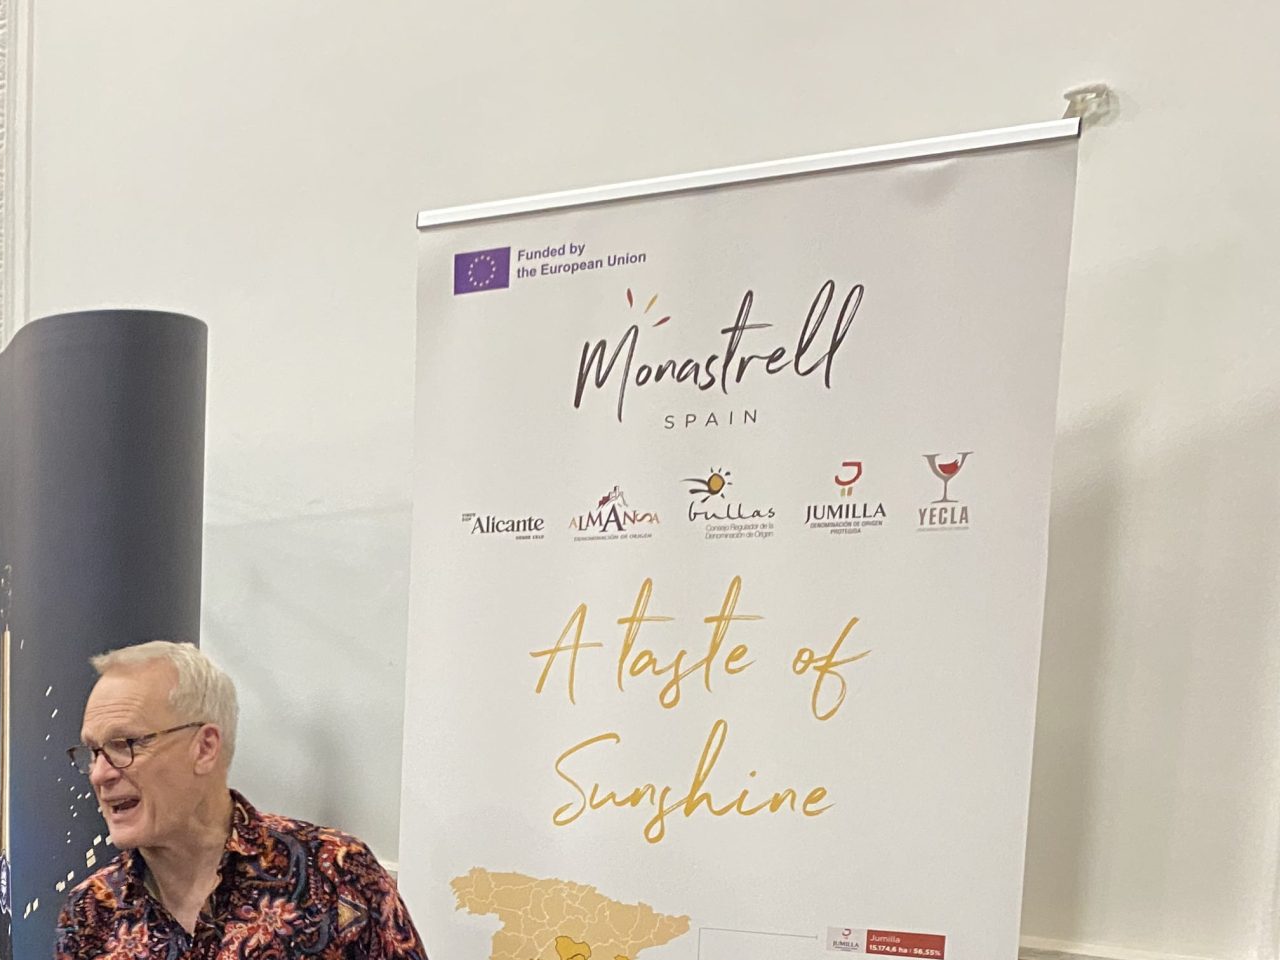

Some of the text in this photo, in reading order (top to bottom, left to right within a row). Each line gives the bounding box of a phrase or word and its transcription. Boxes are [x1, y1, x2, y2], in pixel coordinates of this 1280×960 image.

[518, 243, 586, 262] Funded by
[517, 252, 646, 278] the European Union
[573, 279, 865, 423] Monastrell
[664, 409, 758, 430] SPAIN
[471, 514, 545, 534] Alicante
[569, 503, 660, 533] ALMANSA
[805, 502, 886, 525] JUMILLA
[919, 506, 969, 526] YECLA
[528, 575, 872, 721] A taste of
[552, 718, 836, 844] Sunshine
[869, 935, 901, 944] Jumilla
